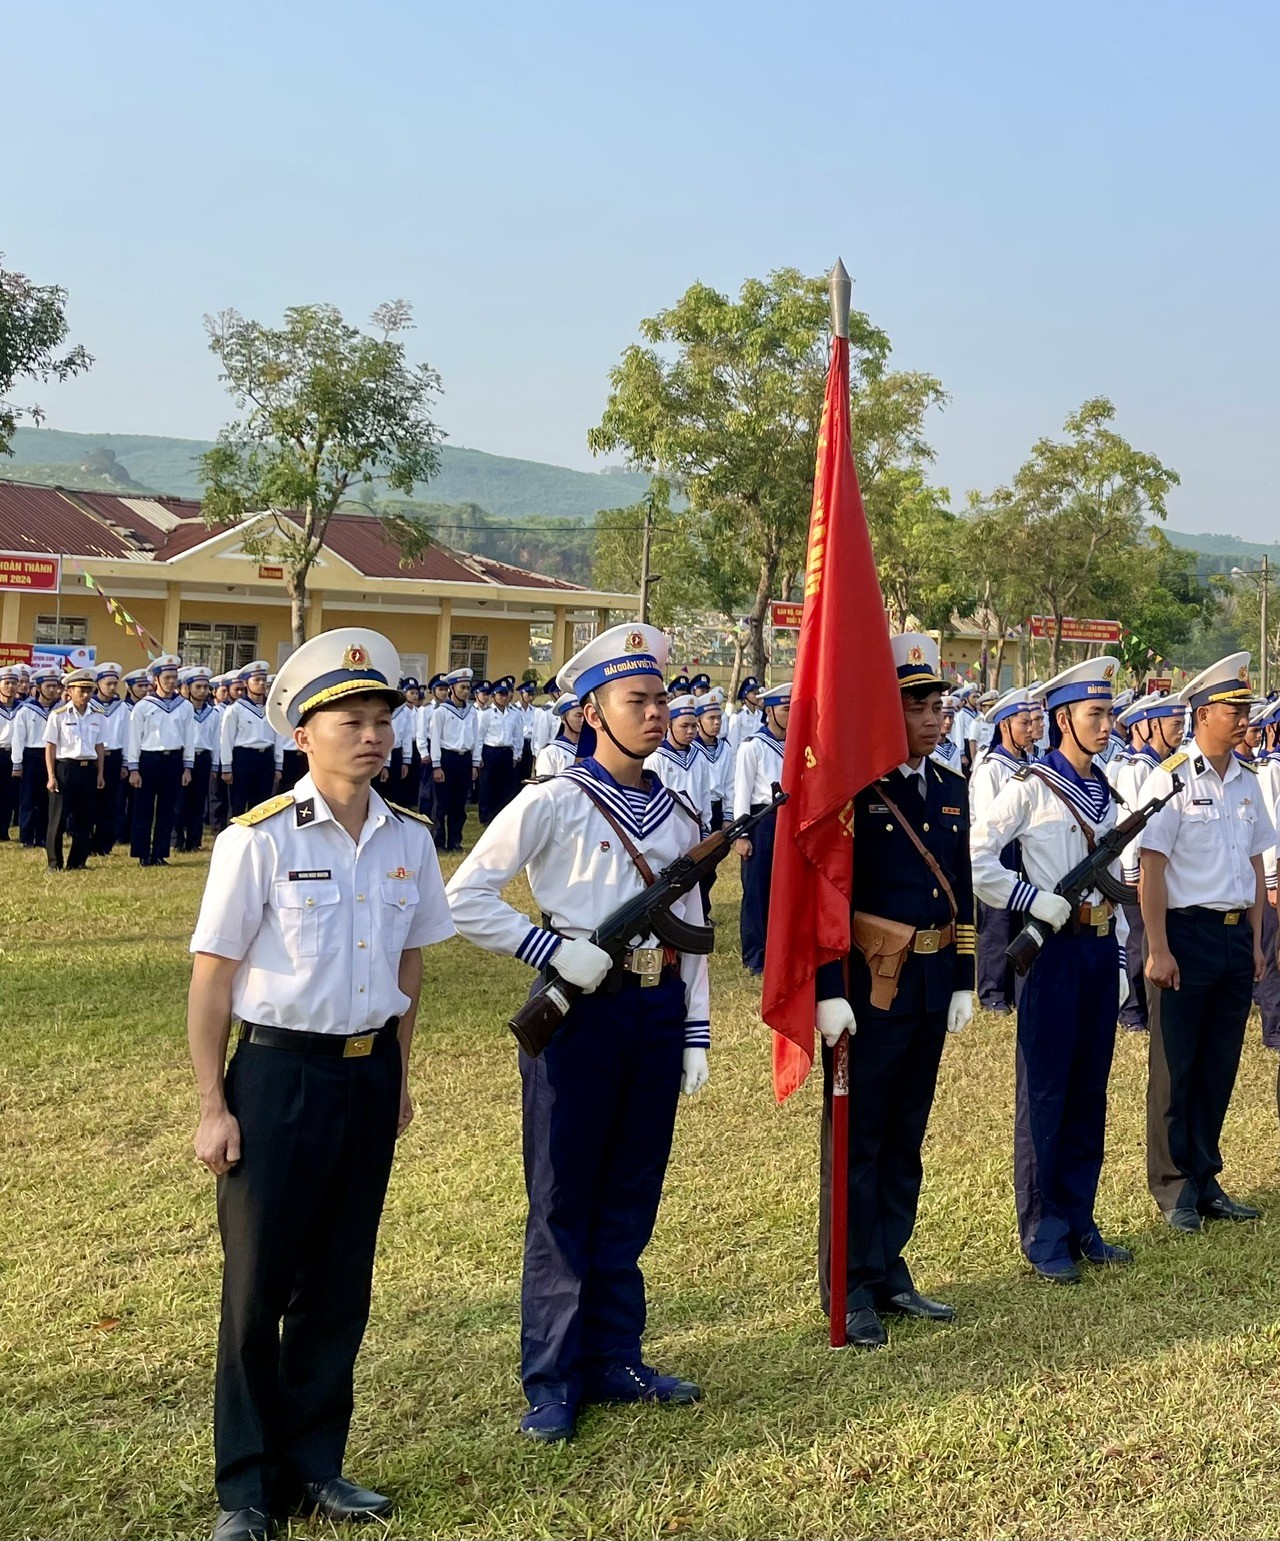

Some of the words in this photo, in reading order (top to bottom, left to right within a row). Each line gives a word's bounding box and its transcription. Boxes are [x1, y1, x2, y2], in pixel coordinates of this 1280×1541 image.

[24, 562, 53, 573] THÀNH
[10, 574, 32, 584] 2024
[604, 663, 617, 676] HẢI
[617, 660, 638, 672] QUÂN
